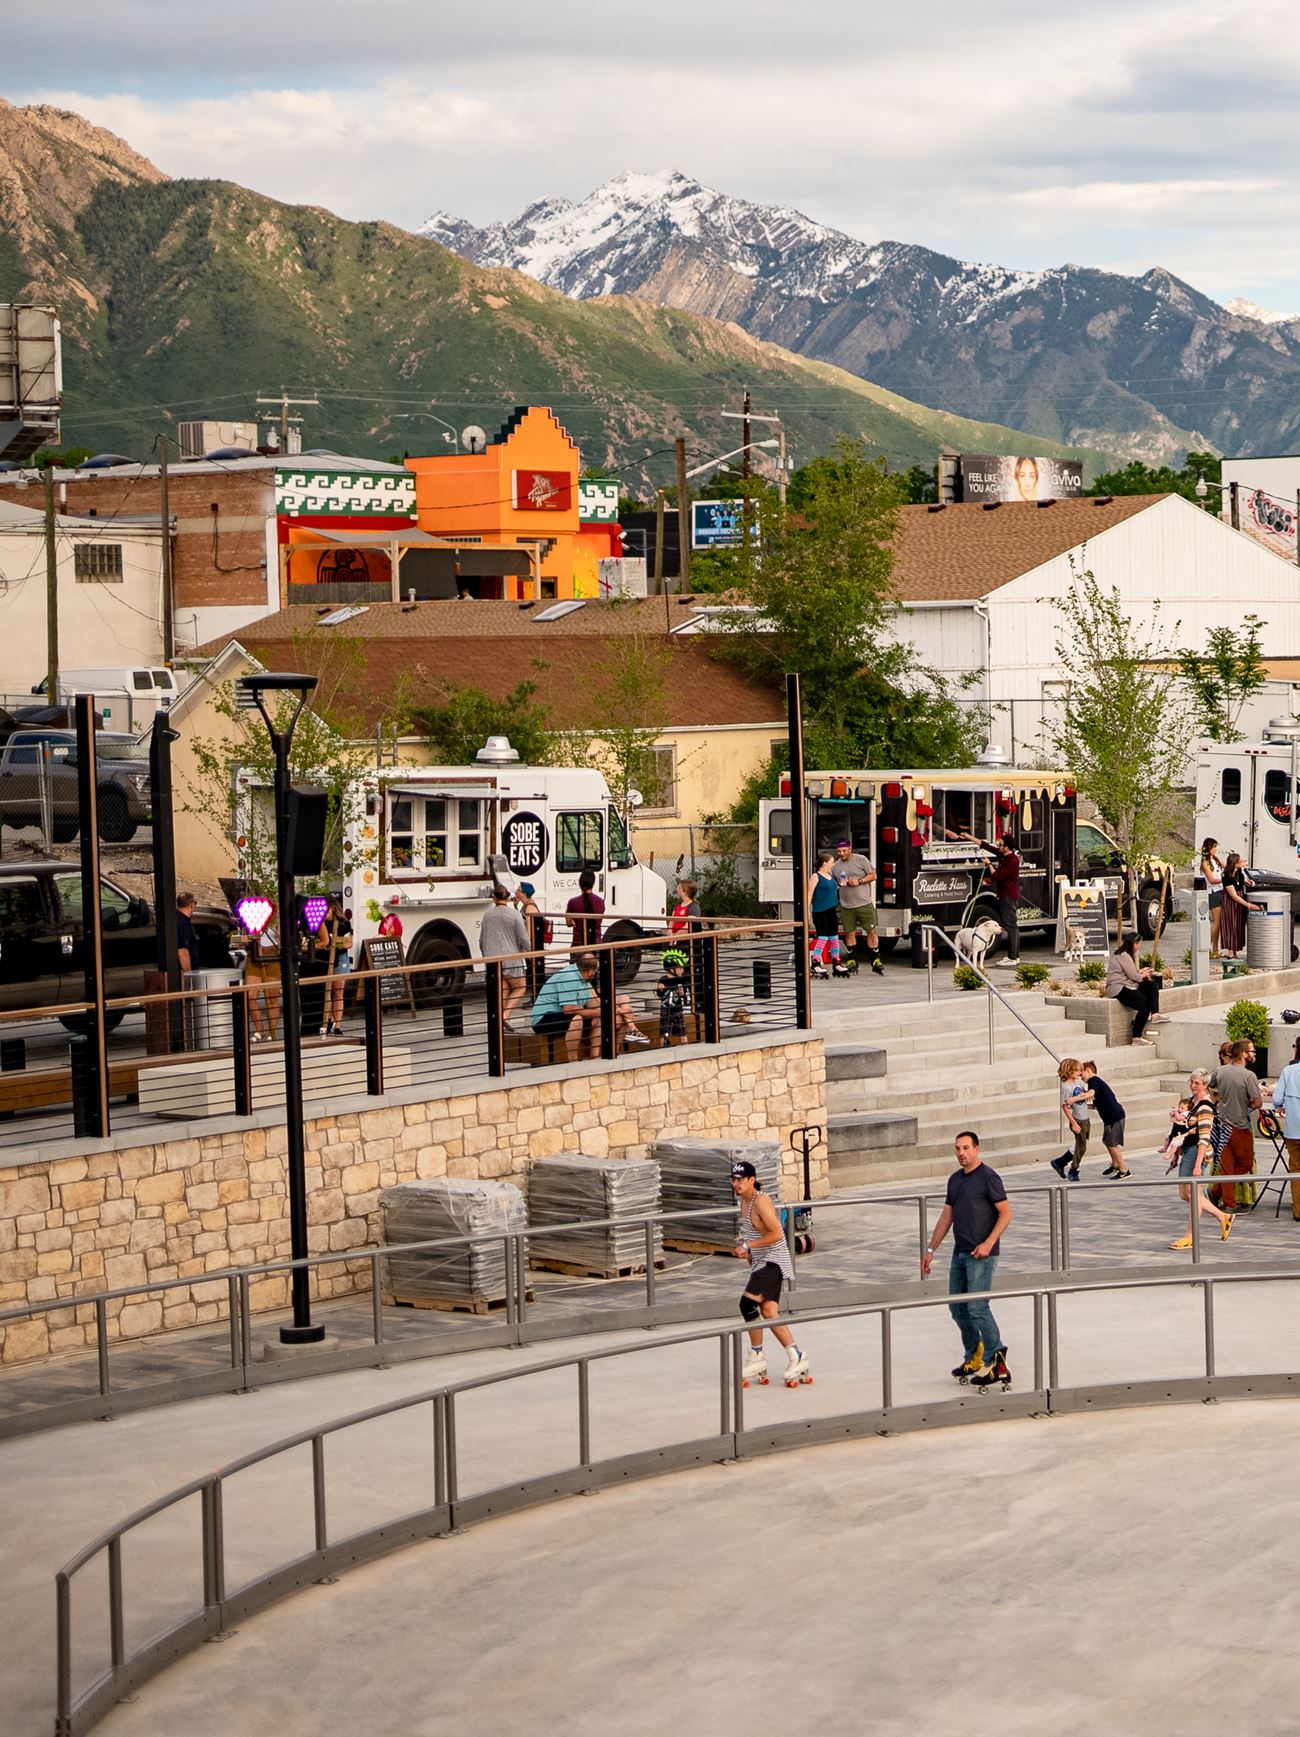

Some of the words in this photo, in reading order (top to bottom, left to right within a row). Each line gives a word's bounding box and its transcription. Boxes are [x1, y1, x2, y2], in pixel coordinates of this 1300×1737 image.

[968, 472, 983, 482] FEEL
[984, 473, 998, 483] LIKE
[1051, 469, 1082, 487] aviva
[968, 483, 984, 493] YOU
[510, 822, 540, 843] SOBE
[510, 845, 540, 867] EATS
[553, 880, 565, 888] WE
[384, 941, 399, 950] EATS
